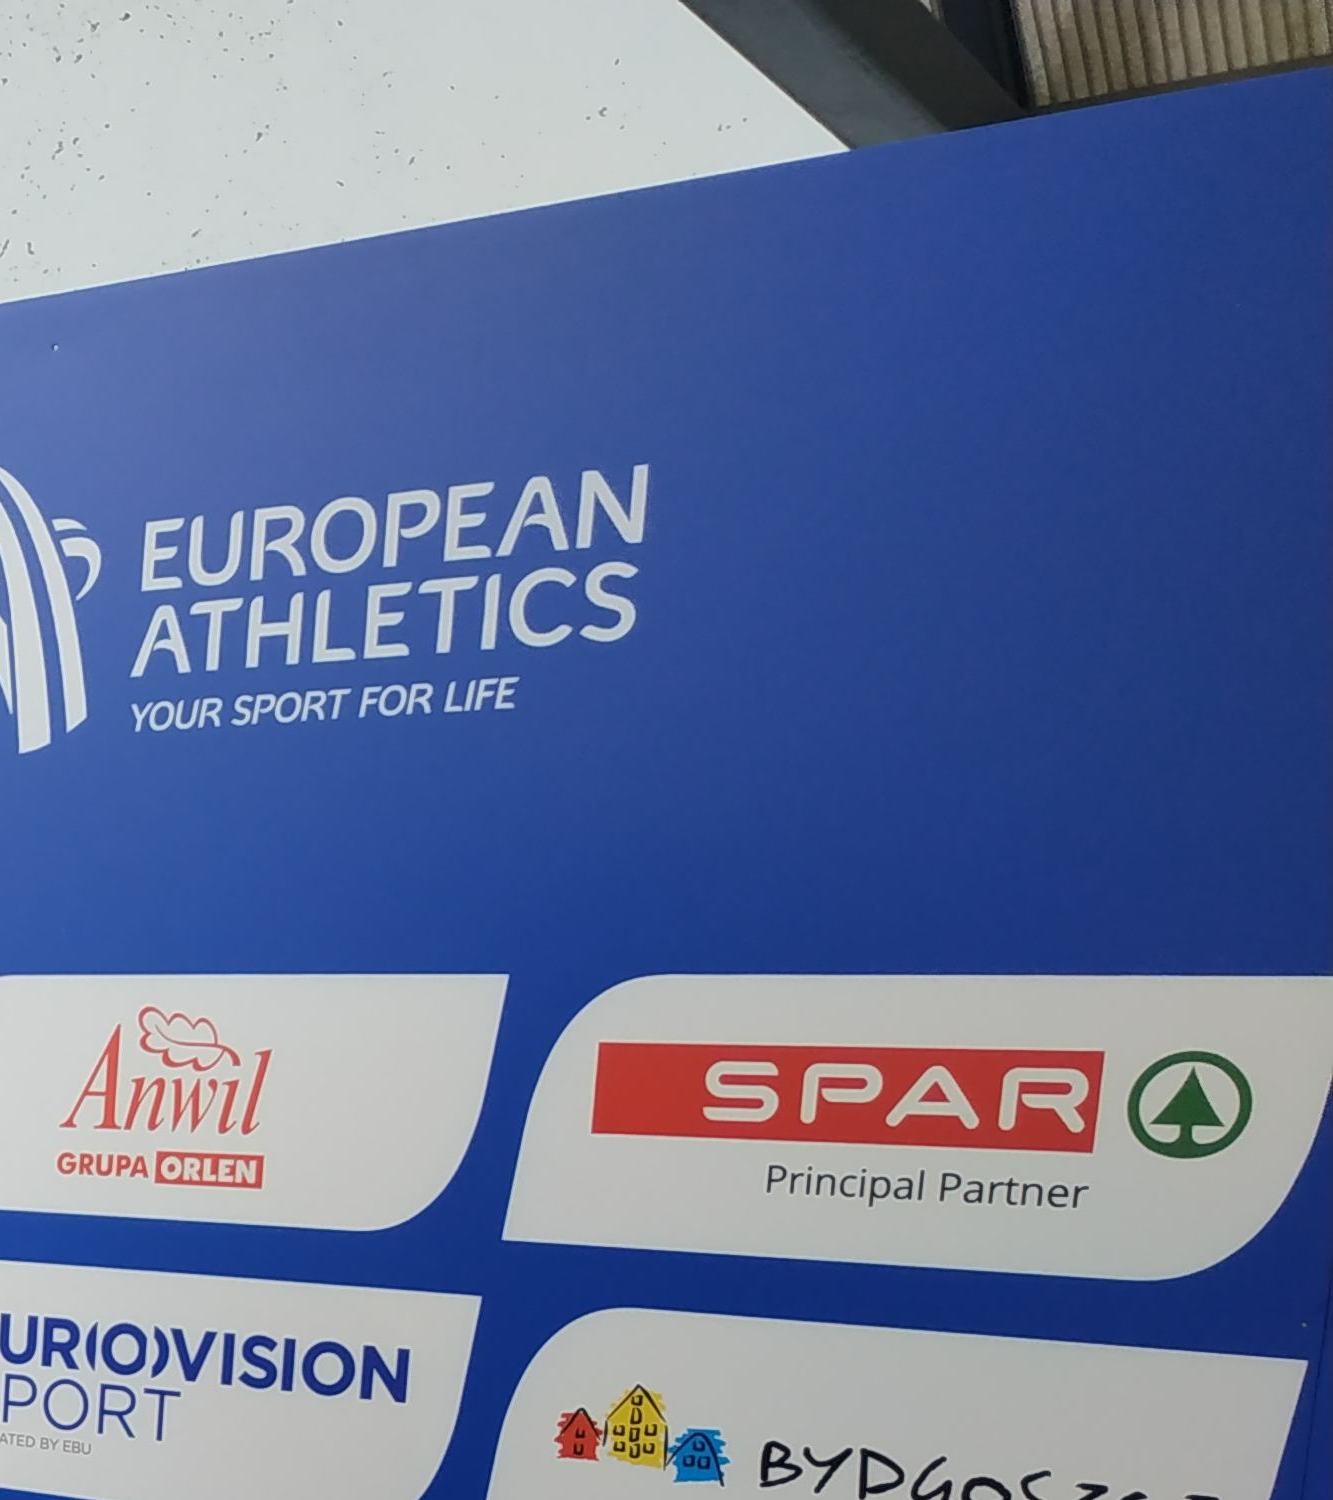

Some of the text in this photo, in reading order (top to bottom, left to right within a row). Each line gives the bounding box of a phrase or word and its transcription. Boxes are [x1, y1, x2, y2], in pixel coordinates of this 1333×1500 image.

[141, 464, 649, 592] EUROPEAN
[131, 562, 639, 678] ATHLETICS
[131, 677, 520, 732] YOUR SPORT FOR LIFE
[59, 1024, 272, 1136] Anwil
[703, 1061, 1090, 1134] SPAR
[57, 1152, 257, 1184] GRUPA ORLEN
[766, 1164, 1089, 1210] Principal Partner
[39, 1438, 60, 1452] BY
[63, 1440, 91, 1455] EBU
